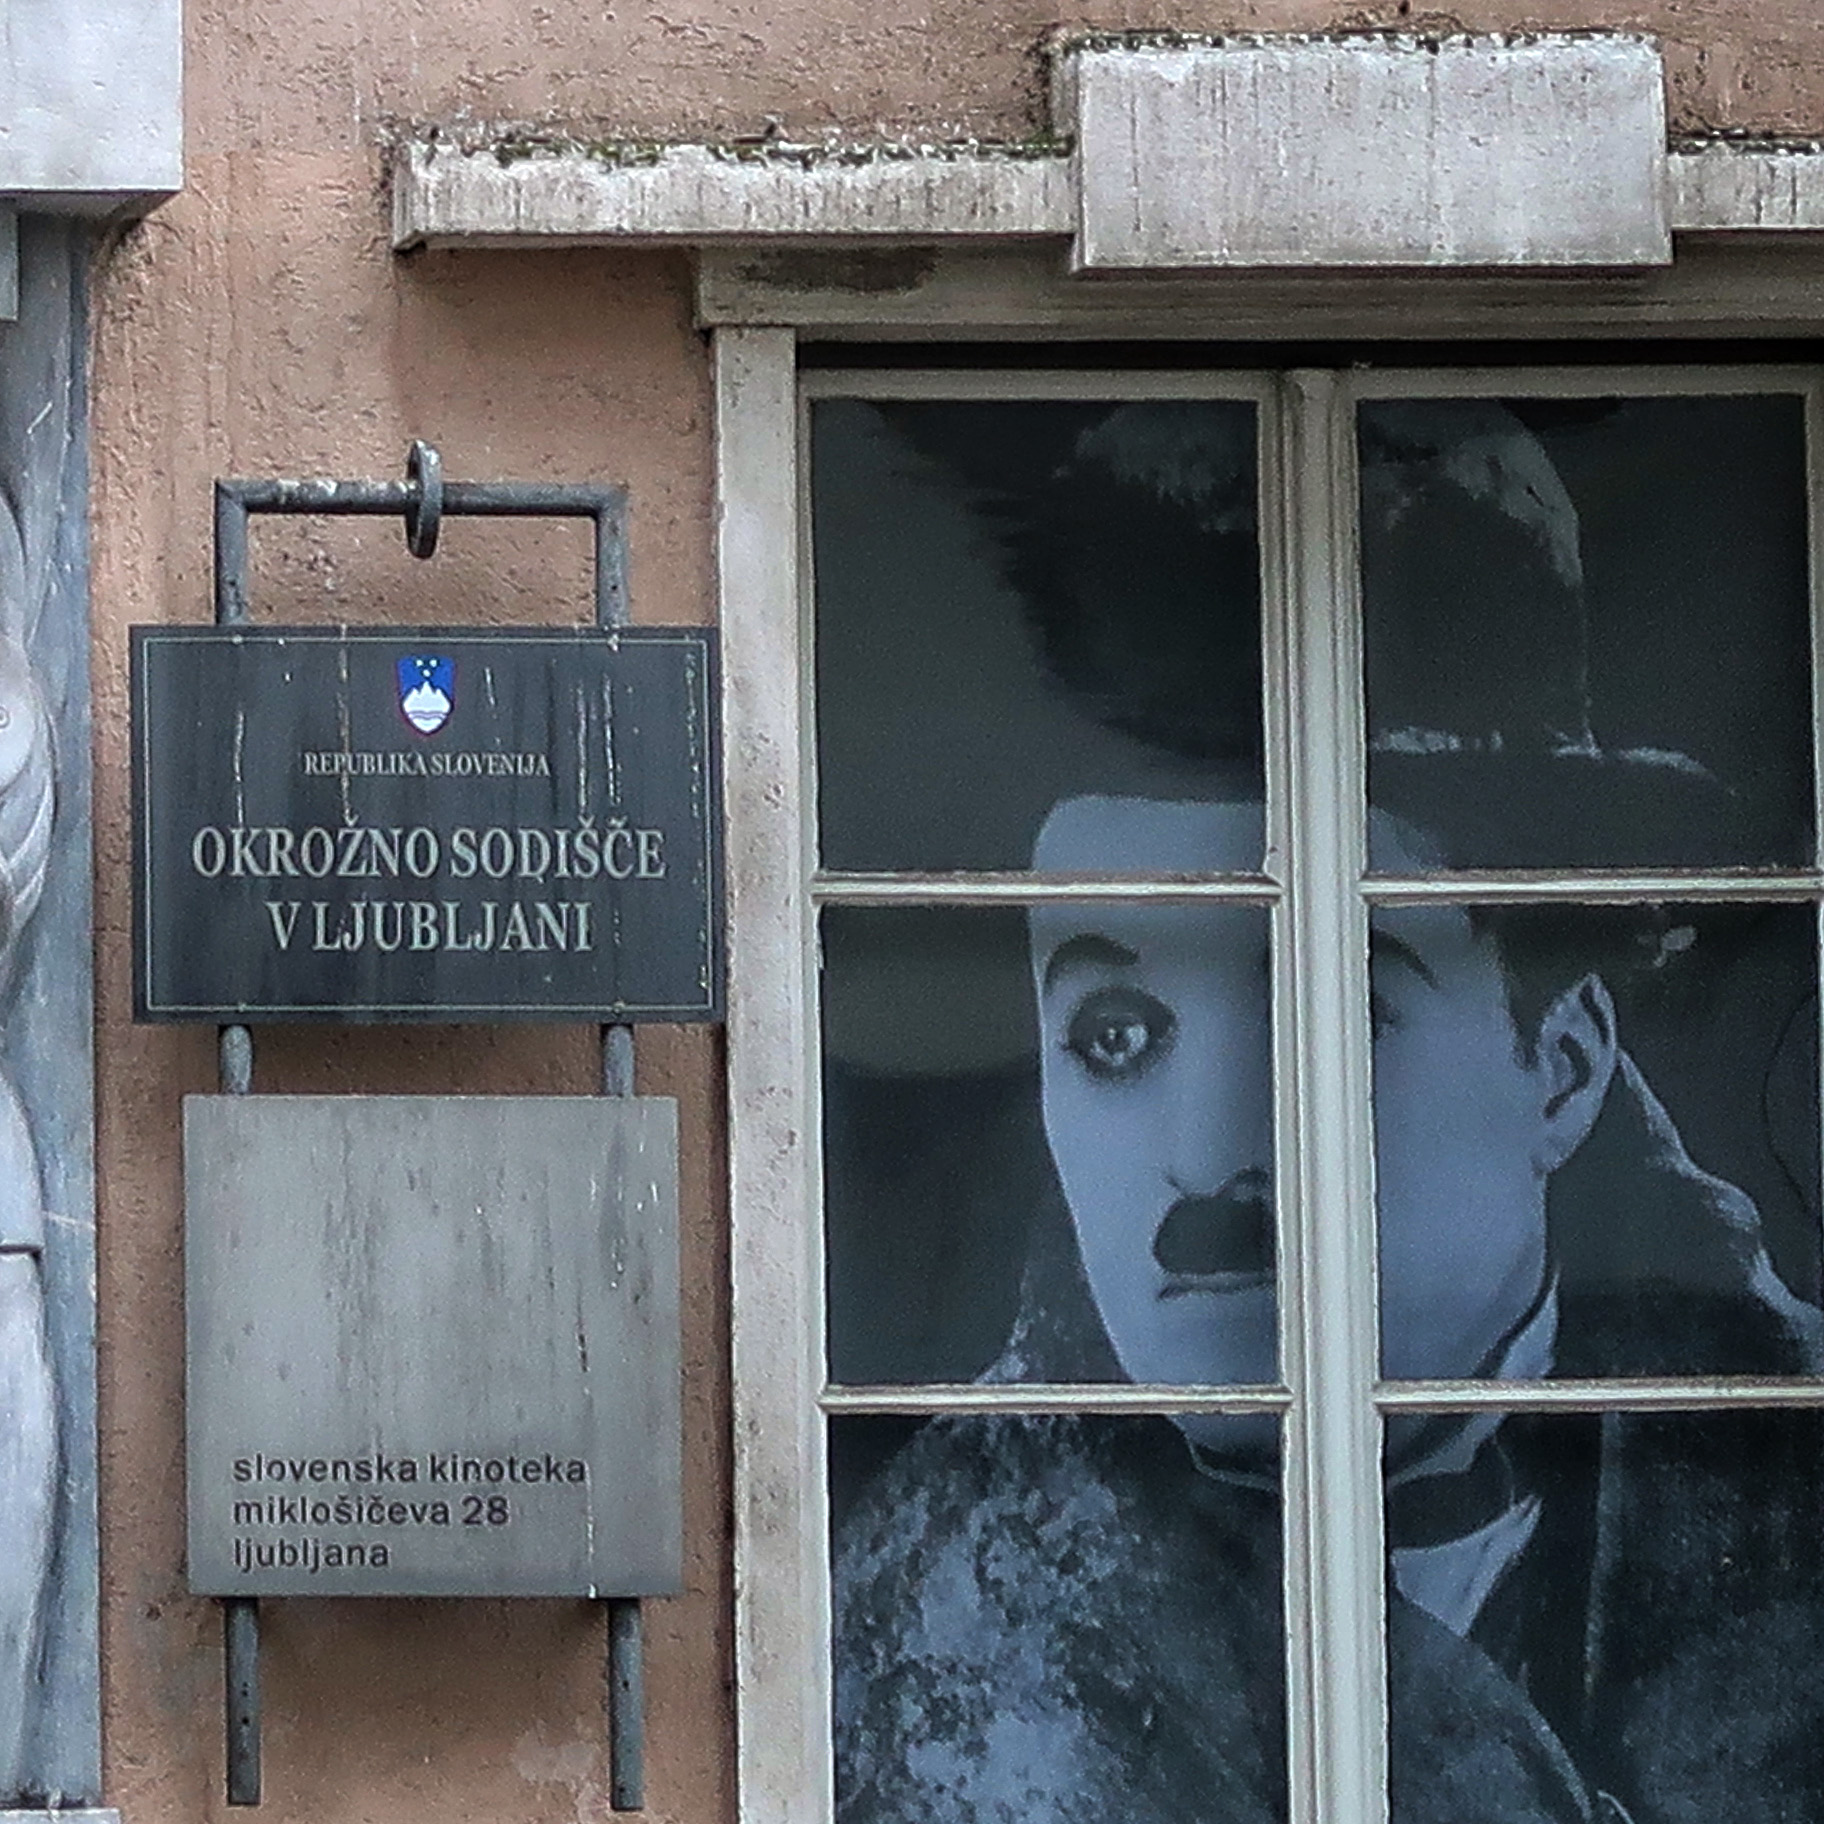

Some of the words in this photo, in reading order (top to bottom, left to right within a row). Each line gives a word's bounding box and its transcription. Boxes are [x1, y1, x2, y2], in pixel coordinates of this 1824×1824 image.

[303, 752, 428, 778] REPUBLIKA
[430, 752, 551, 778] SLOVENIJA
[192, 816, 439, 879] OKROŽNO
[451, 816, 667, 879] SODIŠČE
[266, 900, 303, 950] V
[312, 900, 594, 953] LJUBLJANI
[233, 1454, 418, 1483] slovenska
[430, 1454, 587, 1483] kinoteka
[233, 1495, 451, 1525] miklošičeva
[462, 1496, 510, 1525] 28
[233, 1539, 390, 1574] ljubljana
